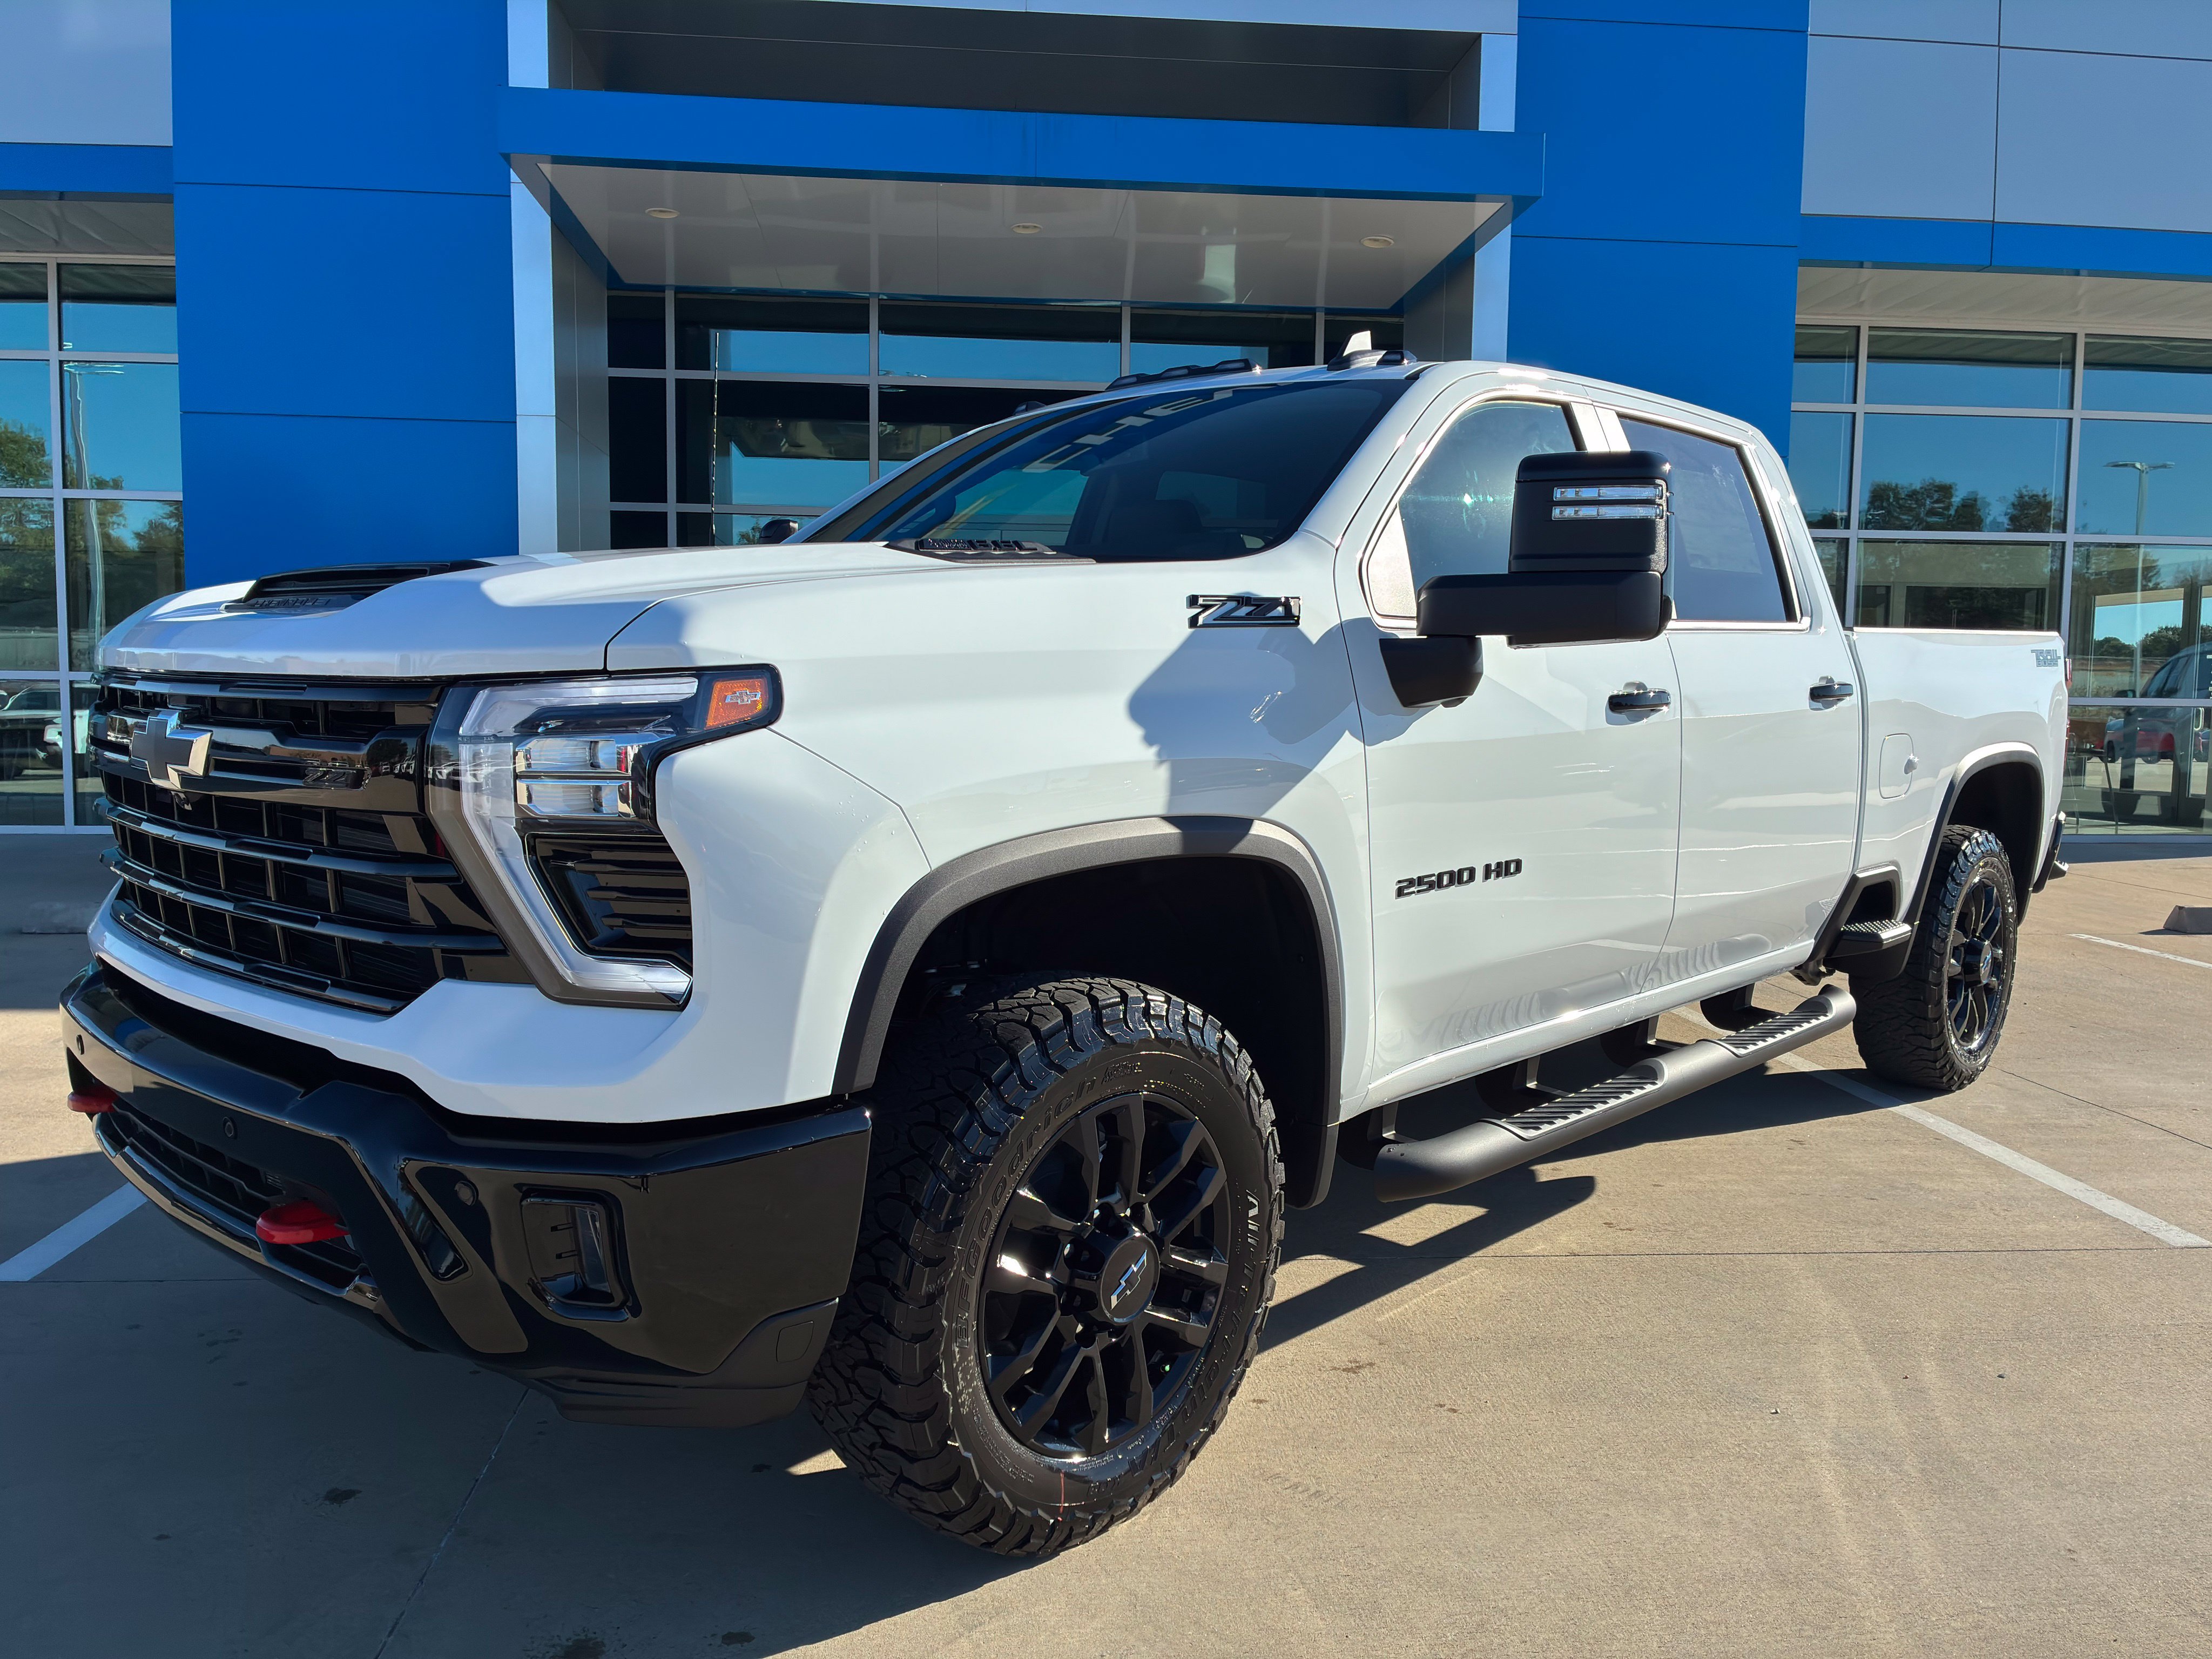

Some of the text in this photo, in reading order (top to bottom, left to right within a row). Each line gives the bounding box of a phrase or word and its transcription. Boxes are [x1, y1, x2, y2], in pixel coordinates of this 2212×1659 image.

[254, 597, 333, 607] CHEVROLET
[1186, 594, 1302, 629] Z71
[2031, 649, 2061, 660] TRAIL
[2036, 659, 2059, 667] BOSS
[1395, 858, 1522, 899] 2500 HD
[955, 1077, 1096, 1348] BFGoodrich
